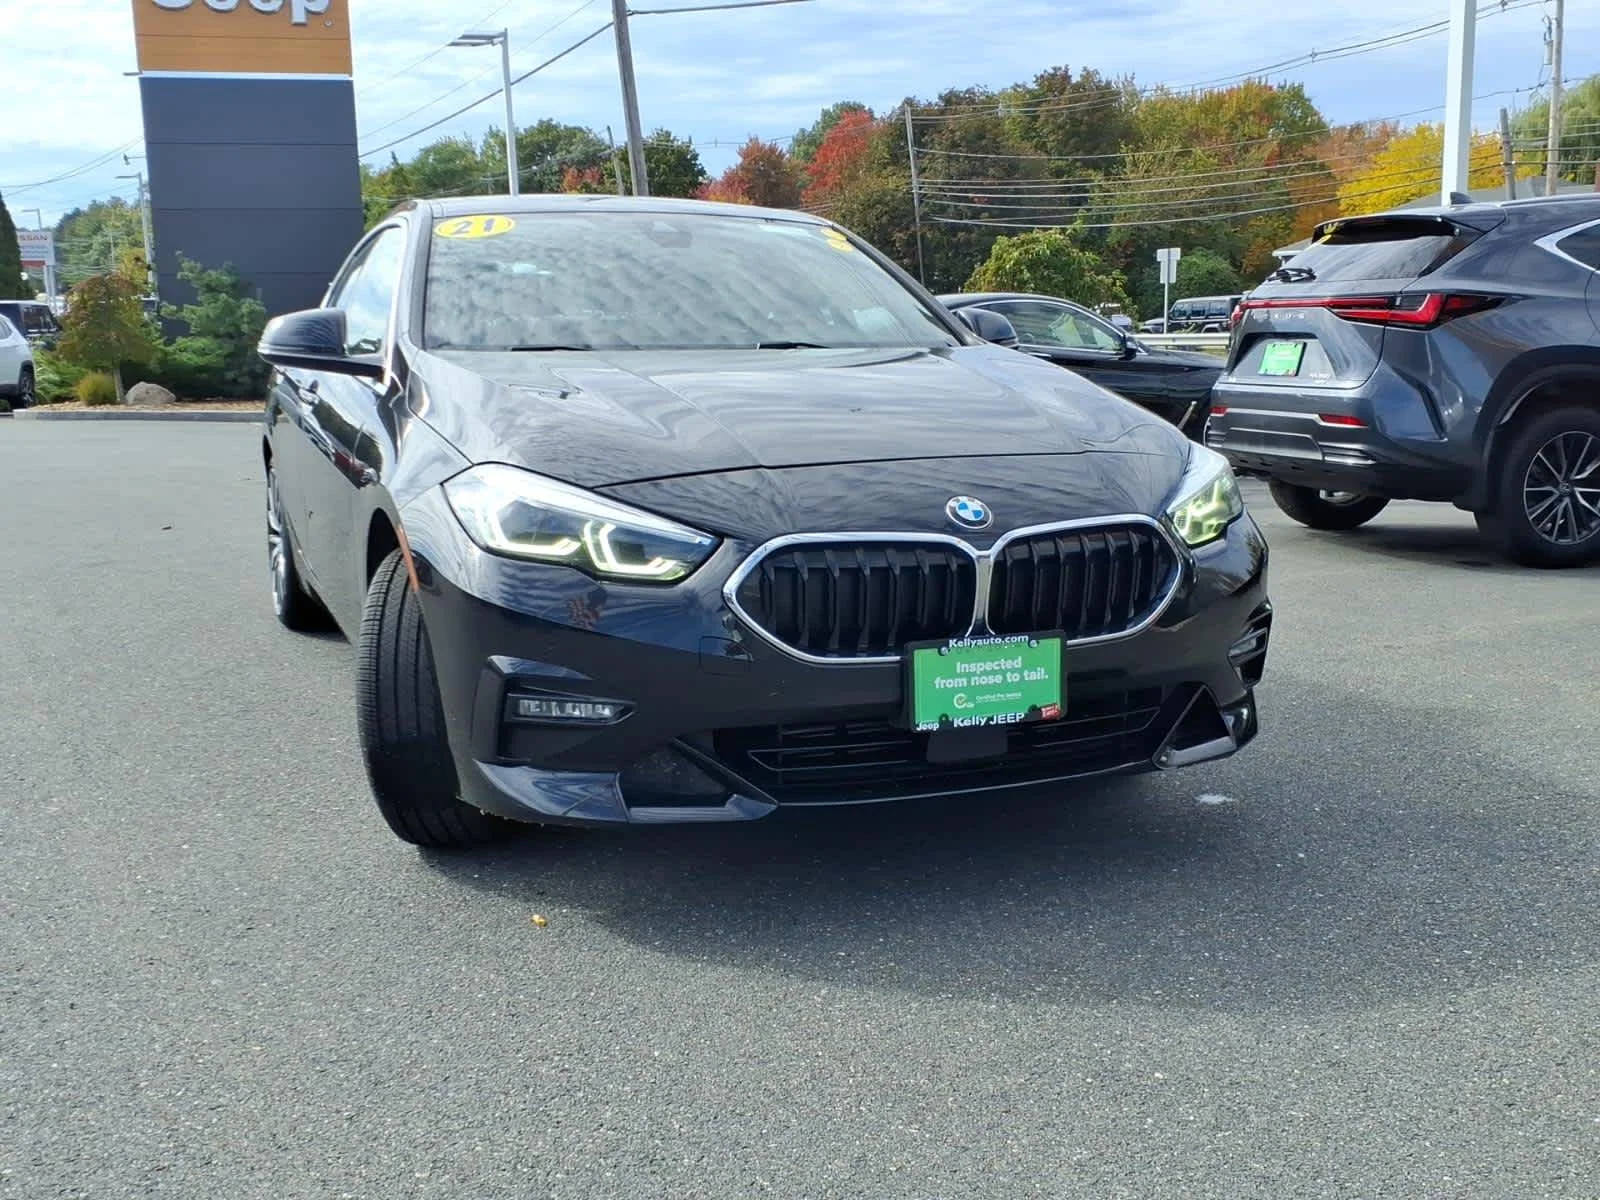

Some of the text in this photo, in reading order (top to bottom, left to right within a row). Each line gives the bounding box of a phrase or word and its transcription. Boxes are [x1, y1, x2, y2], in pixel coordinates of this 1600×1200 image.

[449, 218, 496, 235] 21
[949, 634, 1029, 648] Kellyauto.com
[956, 656, 1022, 674] Inspected
[934, 667, 1049, 689] from nose to tail.
[916, 719, 940, 731] Jeep
[953, 712, 1025, 728] Kelly JEEP
